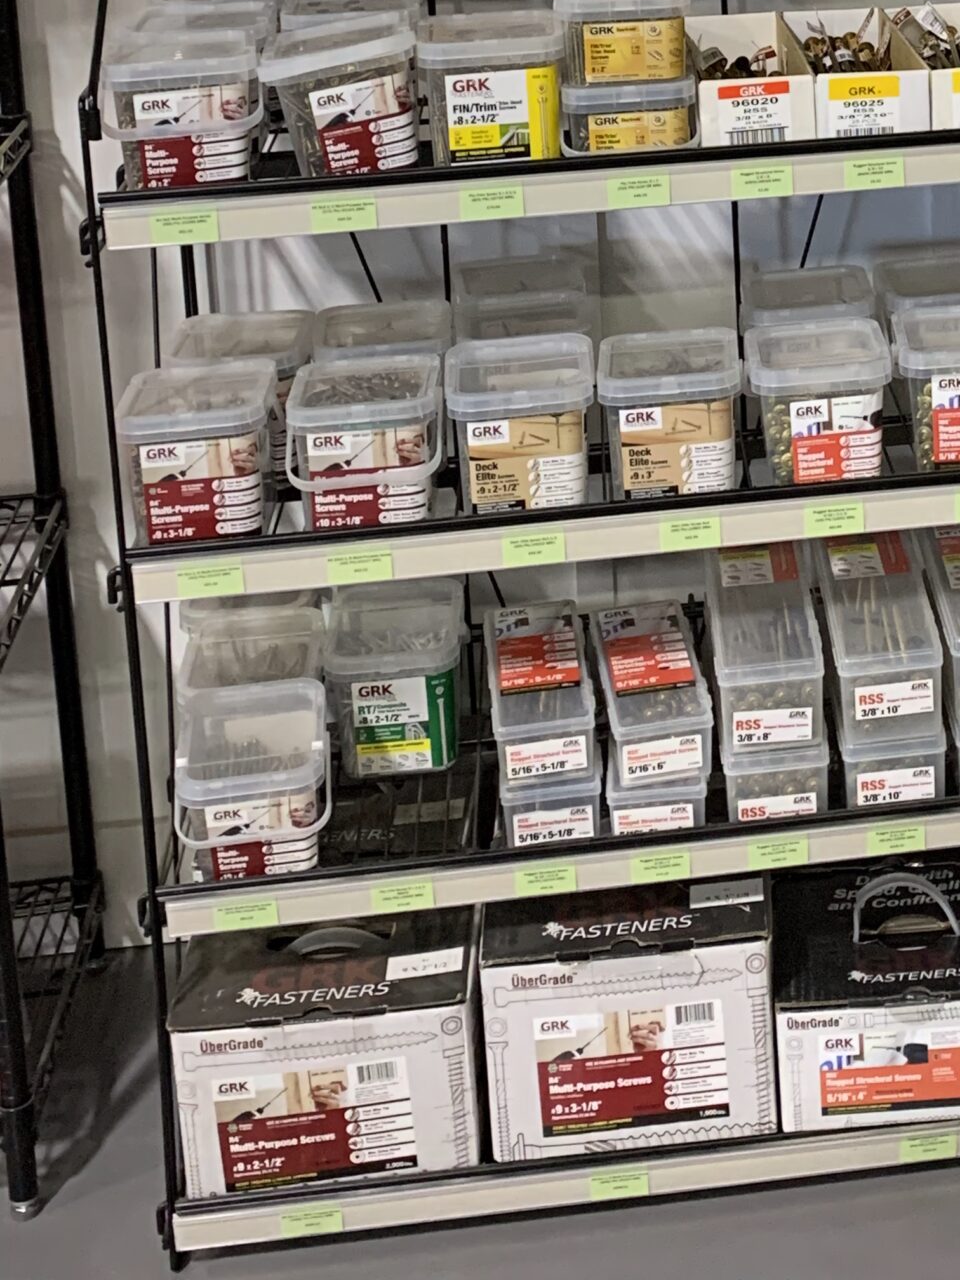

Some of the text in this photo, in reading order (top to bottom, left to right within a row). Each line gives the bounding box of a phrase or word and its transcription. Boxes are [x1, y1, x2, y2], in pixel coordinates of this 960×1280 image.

[452, 78, 490, 93] GRK
[739, 85, 766, 96] GRK
[849, 86, 877, 96] GRK
[317, 93, 347, 107] GRK
[731, 97, 779, 107] 96020
[843, 99, 885, 107] 96025
[453, 102, 497, 114] FIN/Trim
[472, 425, 502, 438] GRK
[147, 448, 177, 460] GRK
[475, 462, 498, 472] Deck
[358, 684, 393, 698] GRK
[859, 693, 884, 706] RSS
[735, 719, 761, 731] RSS
[540, 1020, 570, 1032] GRK
[825, 1038, 853, 1049] GRK
[218, 1082, 249, 1094] GRK
